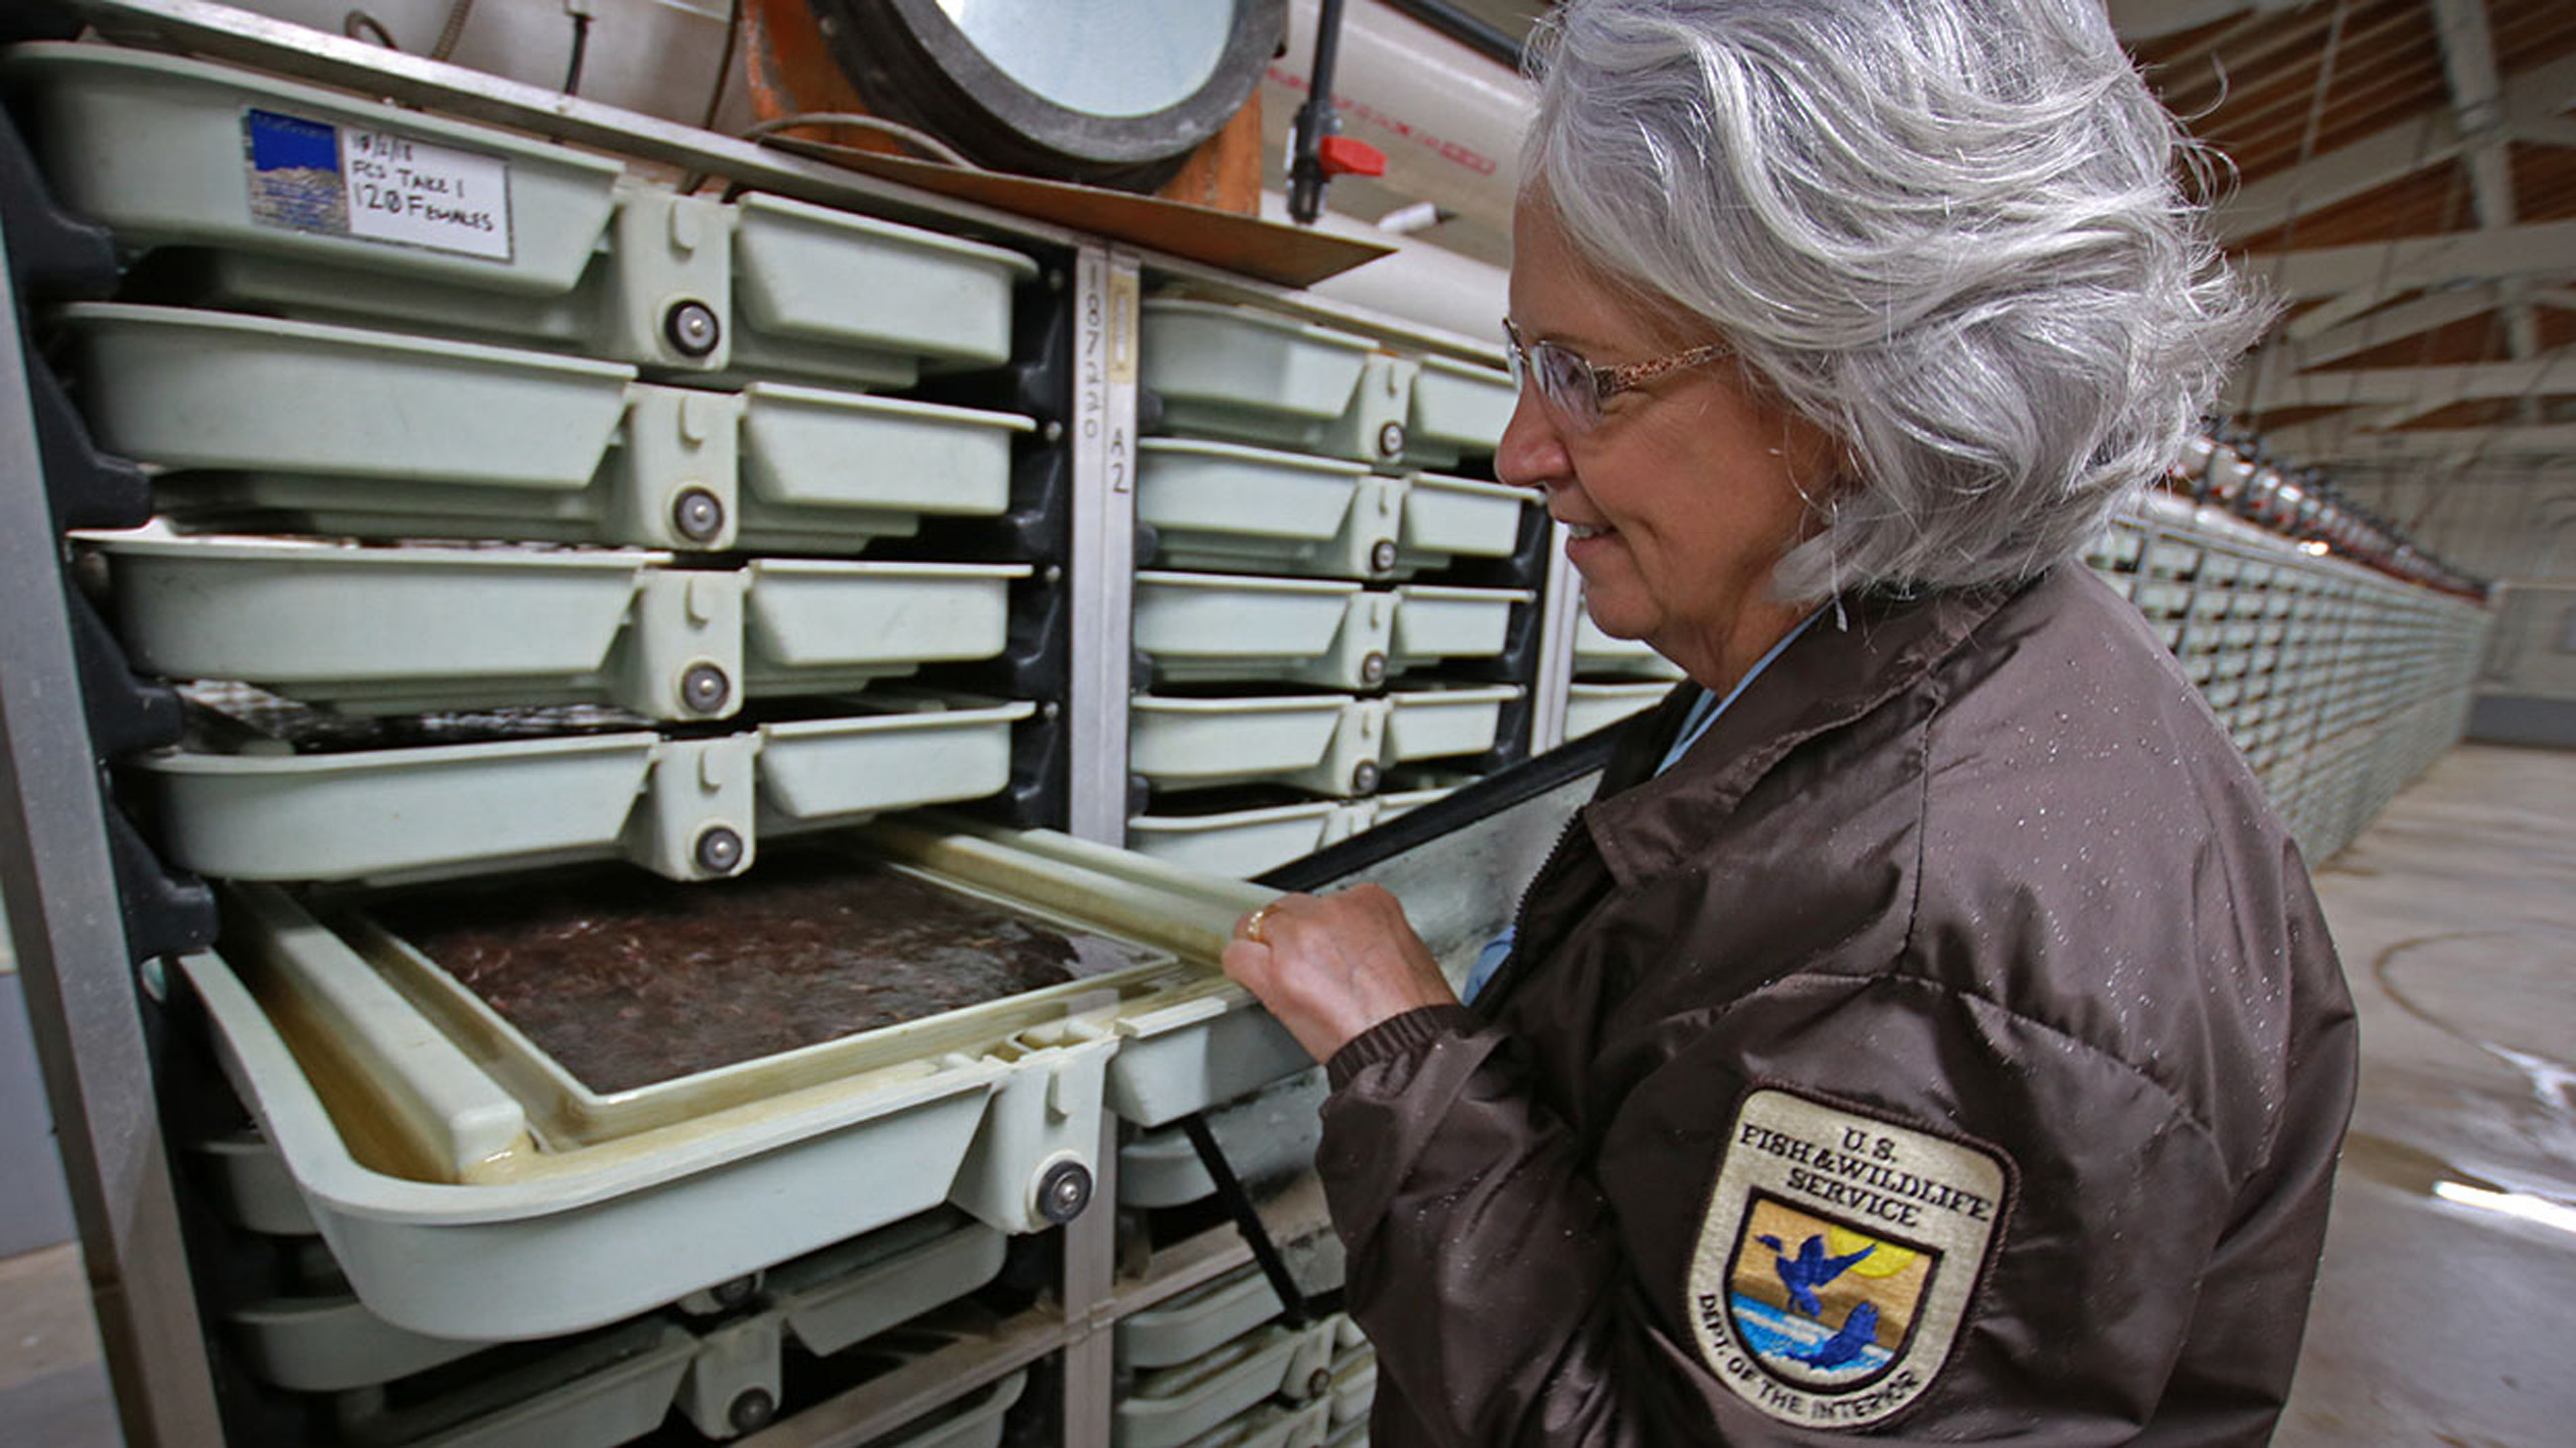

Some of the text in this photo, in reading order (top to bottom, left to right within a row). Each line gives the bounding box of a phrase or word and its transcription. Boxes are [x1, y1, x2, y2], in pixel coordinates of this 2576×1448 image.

[396, 168, 449, 194] TAKE
[1785, 1167, 1923, 1228] SERVICE
[1699, 1293, 1920, 1420] DEPT. OF THE INTERIOR
